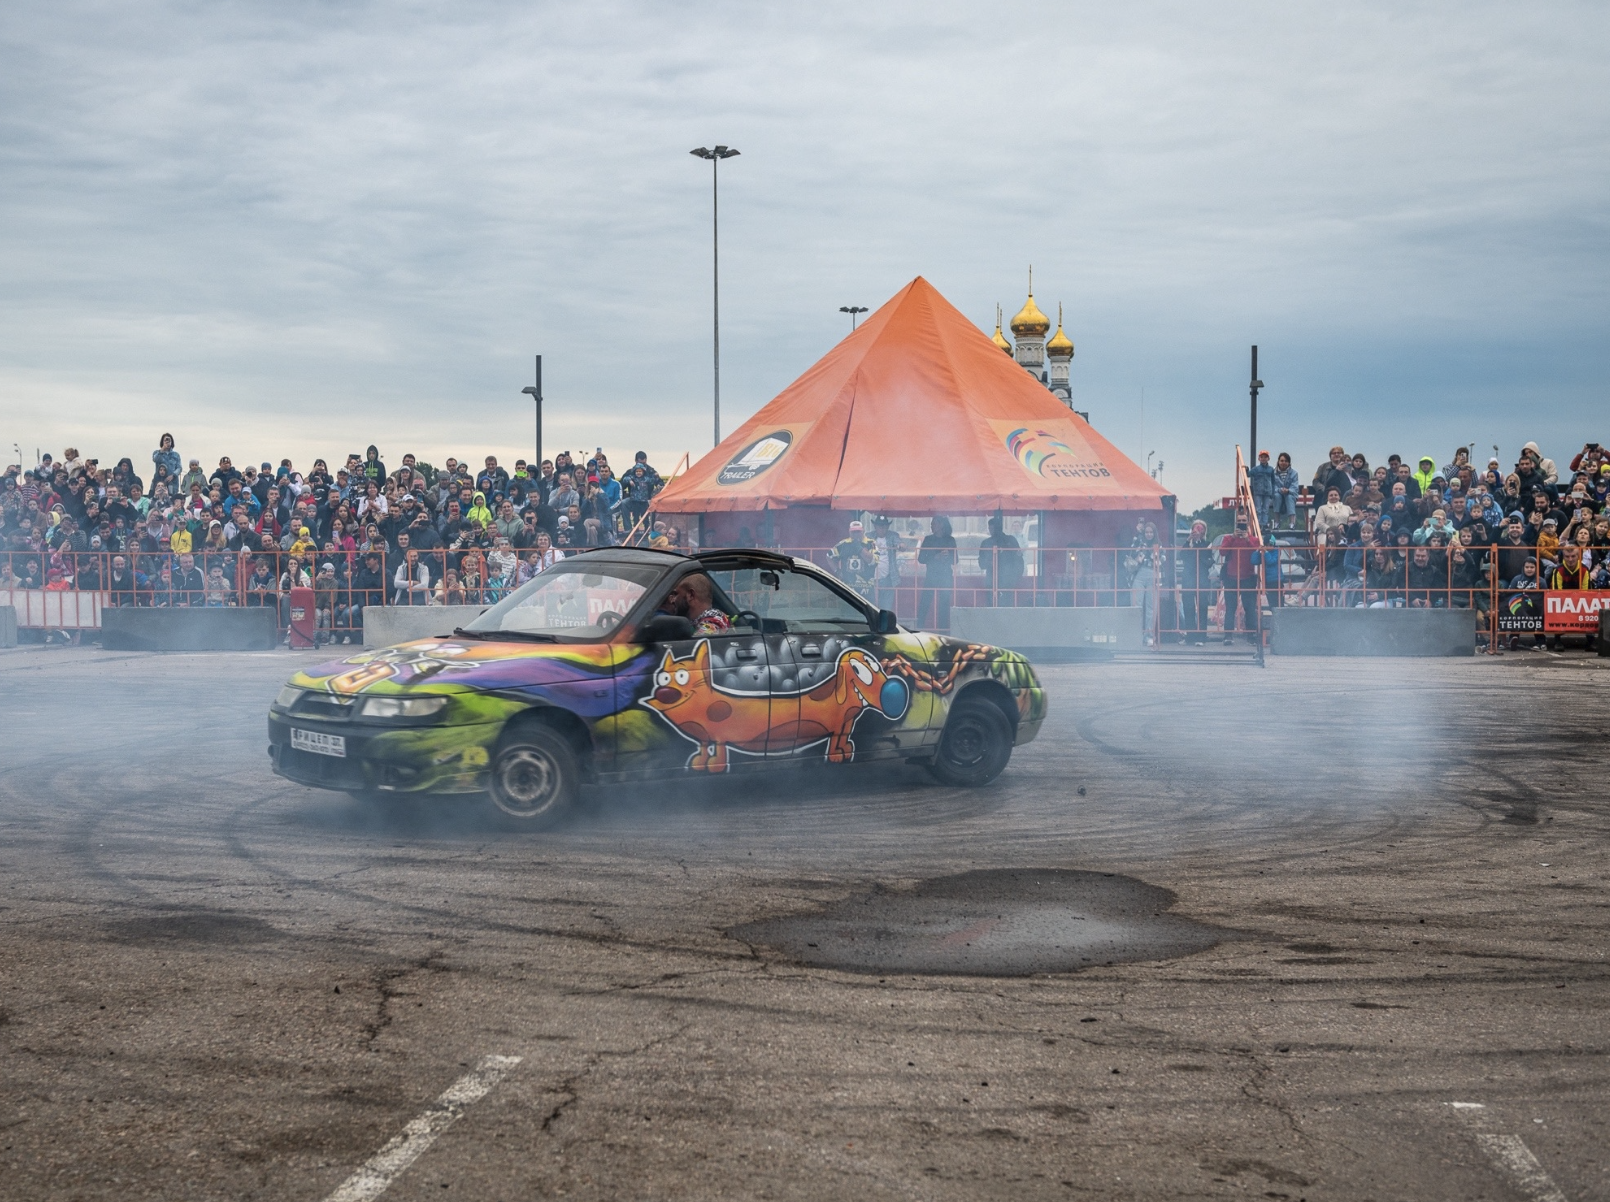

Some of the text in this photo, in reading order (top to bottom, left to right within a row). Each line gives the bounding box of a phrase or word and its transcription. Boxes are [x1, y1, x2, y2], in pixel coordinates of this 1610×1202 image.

[720, 471, 755, 479] TRAILER
[1050, 468, 1110, 478] ТЕНТОВ
[1499, 620, 1543, 629] ТЕНТОВ
